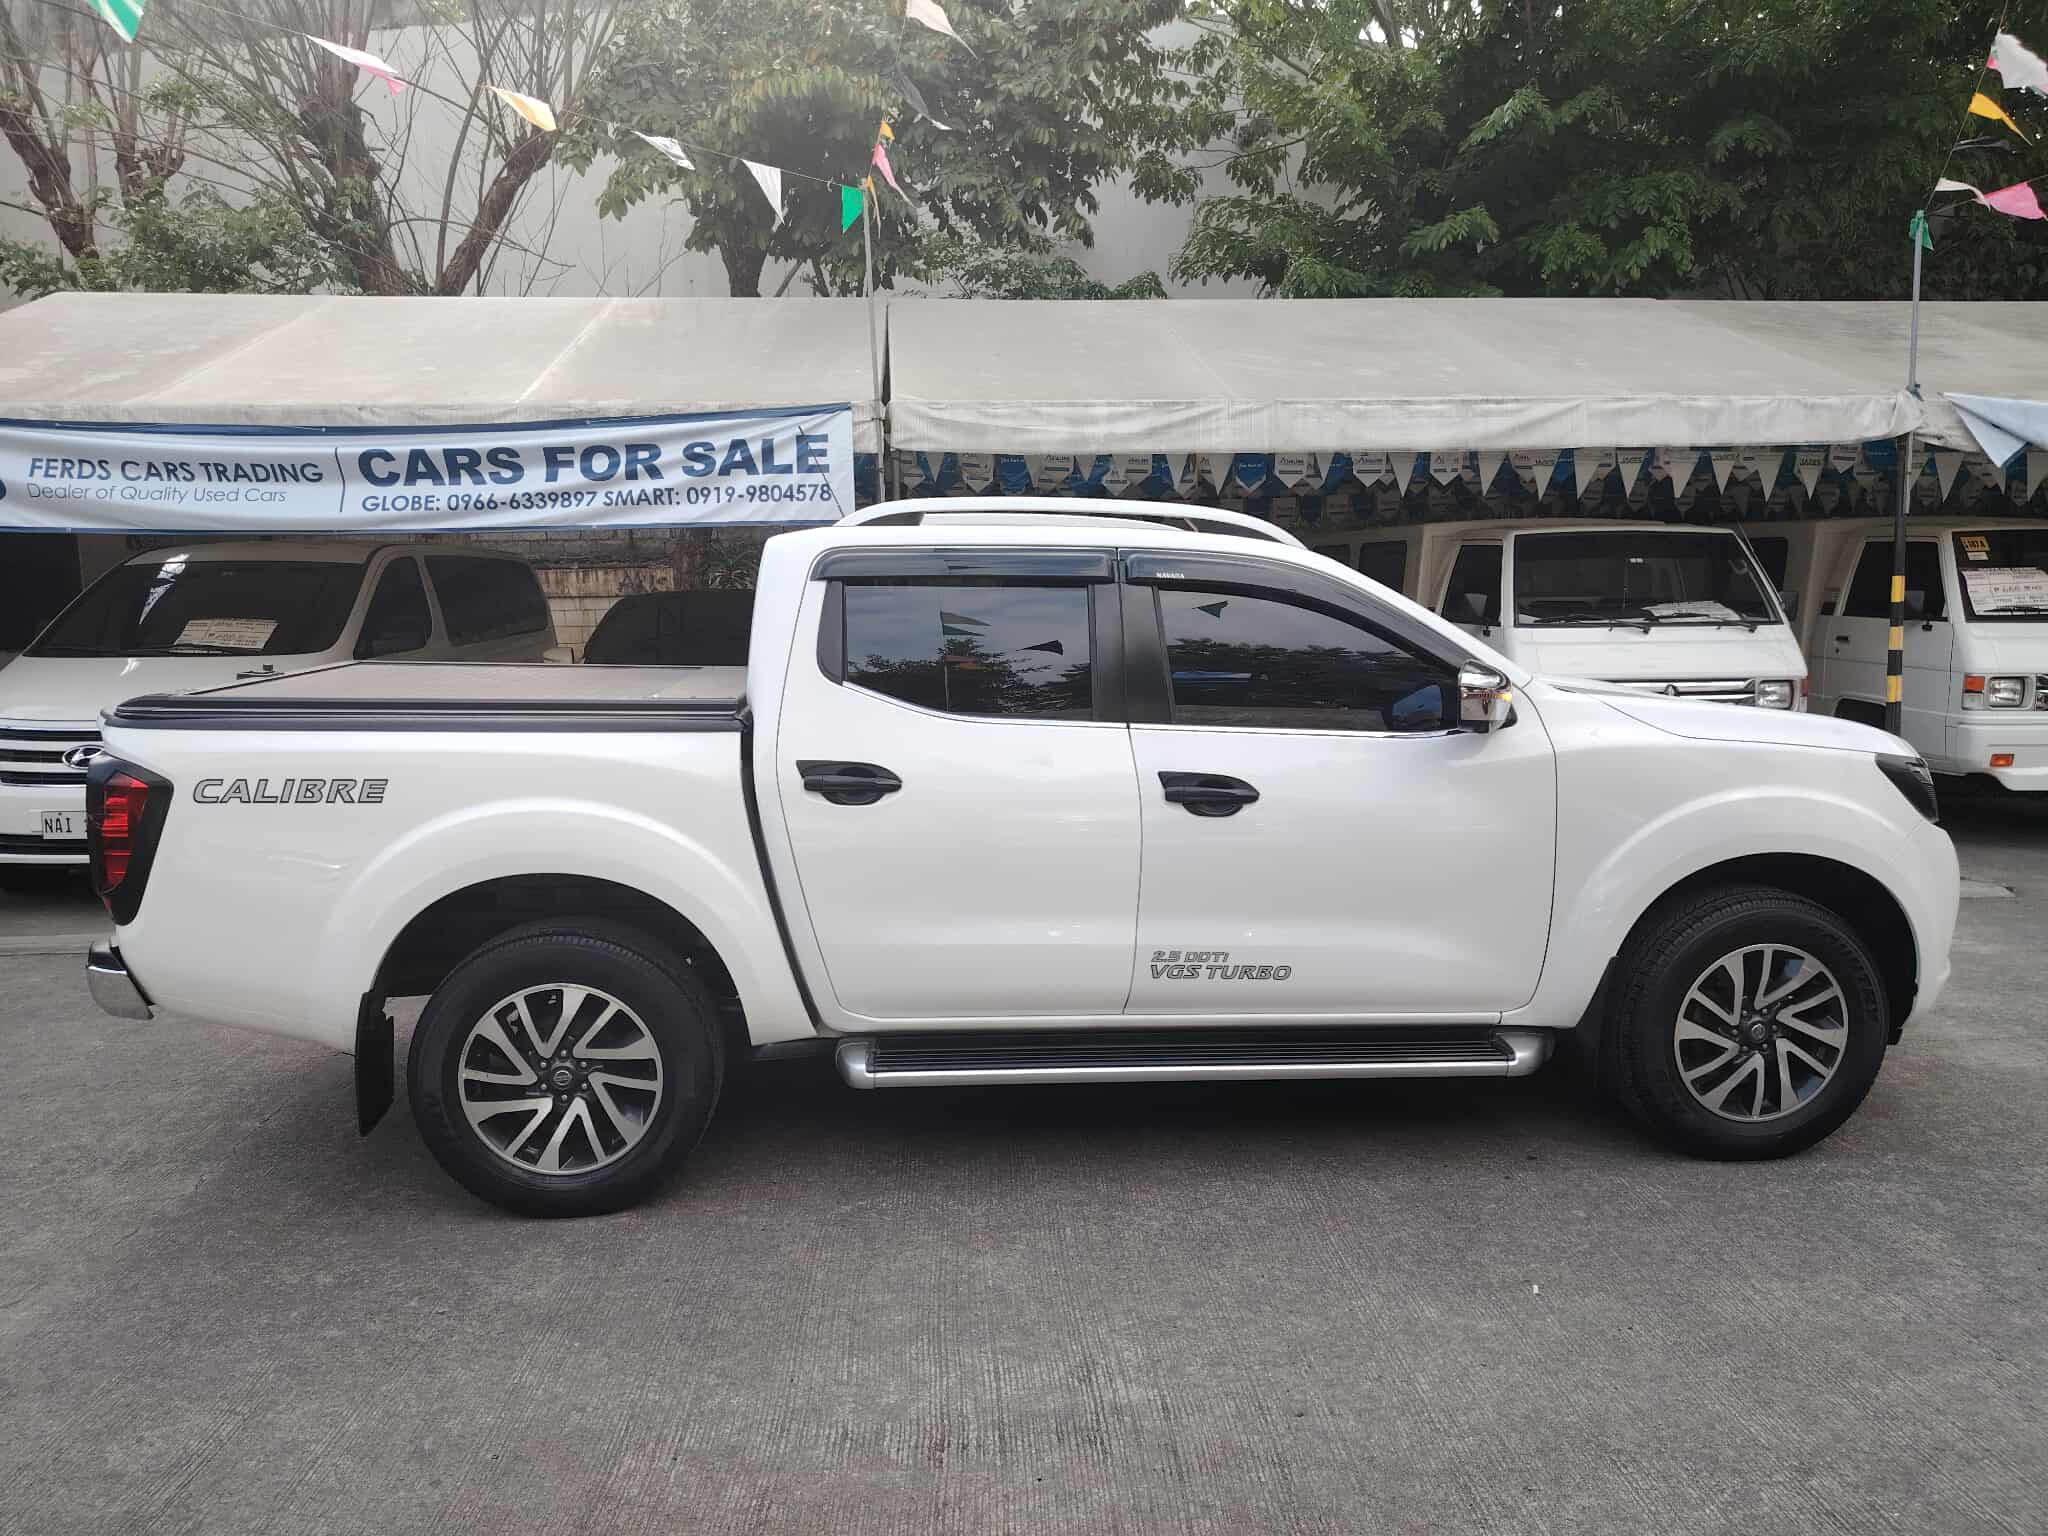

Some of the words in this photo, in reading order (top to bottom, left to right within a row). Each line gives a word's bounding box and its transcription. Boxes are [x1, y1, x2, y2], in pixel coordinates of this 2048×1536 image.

[29, 457, 112, 480] FERDS
[120, 460, 196, 482] CARS
[198, 461, 323, 483] TRADING
[358, 446, 525, 487] CARS
[543, 444, 664, 483] FOR
[681, 434, 830, 477] SALE
[26, 482, 91, 500] Dealer
[95, 485, 117, 500] of
[120, 486, 188, 504] Quality
[193, 487, 240, 502] Used
[244, 488, 288, 502] Cars
[362, 495, 441, 512] GLOBE:
[447, 489, 598, 511] 0966-6339897
[602, 487, 681, 507] SMART:
[686, 483, 832, 505] 0919-9804578
[193, 778, 389, 804] CALIBRE
[44, 817, 73, 833] NAI
[1151, 950, 1182, 963] 2.5
[1150, 964, 1202, 980] VGS
[1205, 965, 1292, 981] TURBO
